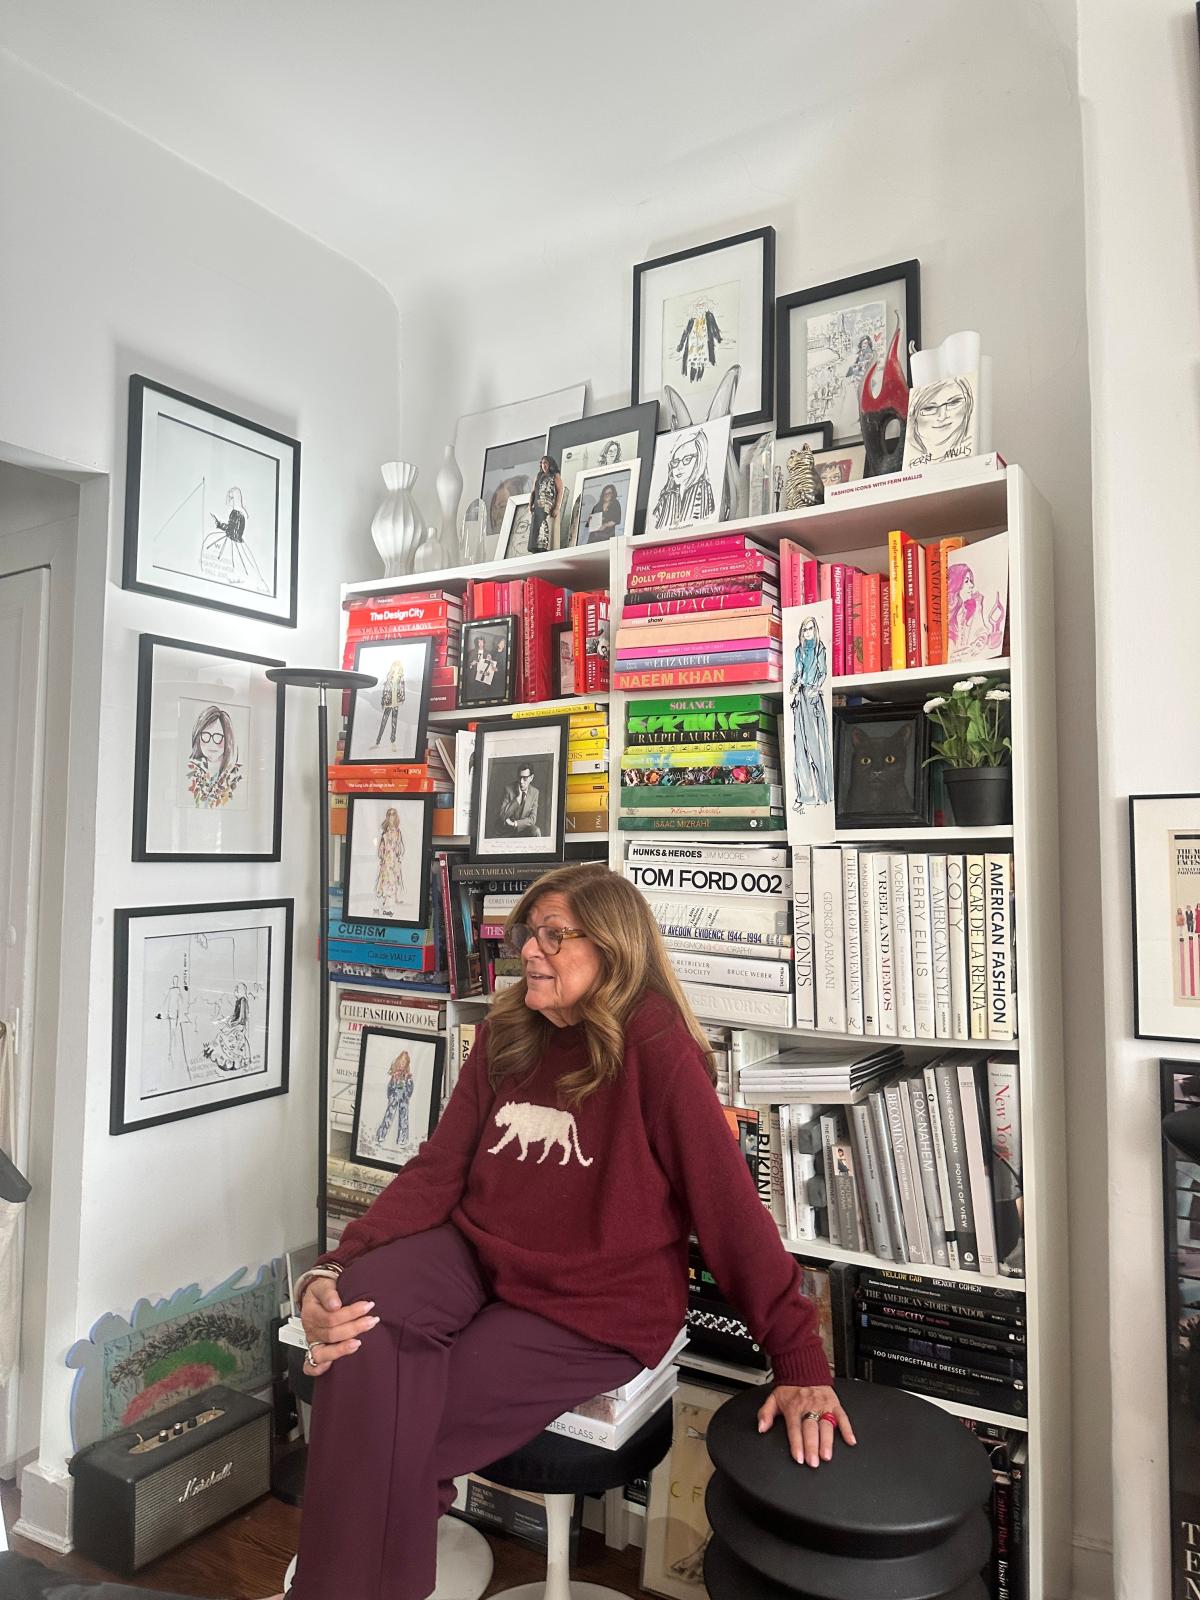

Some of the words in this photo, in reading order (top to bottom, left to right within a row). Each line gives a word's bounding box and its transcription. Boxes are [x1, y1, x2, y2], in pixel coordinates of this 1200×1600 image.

[831, 488, 854, 497] FASHION
[855, 484, 872, 492] ICONS
[872, 481, 887, 489] WITH
[887, 478, 902, 486] FERN
[902, 473, 923, 483] MALLIS
[631, 574, 656, 586] DOLLY
[657, 569, 691, 583] PARTON
[370, 612, 383, 621] The
[384, 609, 408, 620] Design
[408, 608, 424, 618] City
[646, 594, 730, 616] IMPACT
[882, 587, 890, 627] VIVIENNE
[653, 655, 710, 668] ELIZABETH
[619, 672, 674, 687] NAEEM
[678, 669, 725, 685] KHAN
[669, 701, 716, 710] SOLANGE
[638, 733, 676, 744] RALPH
[680, 730, 727, 741] LAUREN
[654, 819, 675, 828] ISAAC
[677, 818, 710, 827] MIZRAHI
[632, 848, 661, 857] HUNKS
[668, 850, 702, 858] HEROES
[719, 852, 745, 860] MOORE
[847, 856, 856, 880] THE
[630, 867, 674, 887] TOM
[679, 870, 738, 891] FORD
[741, 873, 782, 894] 002
[860, 863, 868, 898] MANOLO
[894, 864, 904, 902] VICENTE
[913, 865, 926, 920] PERRY
[969, 864, 984, 912] OSCAR
[878, 870, 890, 954] VREELAND
[948, 863, 963, 932] COTY
[990, 862, 1004, 945] AMERICAN
[823, 891, 834, 939] GIORGIO
[896, 905, 906, 932] WOLF
[933, 887, 948, 962] AMERICAN
[970, 917, 985, 937] DE
[338, 924, 386, 938] CUBISM
[667, 927, 691, 938] AVEDON
[694, 928, 724, 940] EVIDENCE
[795, 892, 812, 987] DIAMONDS
[677, 960, 710, 968] RETRIEVER
[915, 930, 928, 977] ELLIS
[971, 942, 985, 959] LA
[750, 971, 772, 979] WEBER
[824, 943, 835, 990] ARMANI
[849, 936, 861, 1004] MOVEMENT
[881, 957, 893, 1011] MEMOS
[936, 967, 950, 1008] STYLE
[972, 965, 986, 1011] RENTA
[992, 952, 1006, 1023] FASHION
[944, 1076, 952, 1106] TONNE
[887, 1093, 904, 1153] BECOMING
[913, 1091, 934, 1172] FOX-NAHEM
[947, 1107, 958, 1153] GOODMAN
[758, 1134, 771, 1202] BIKINI
[771, 1153, 780, 1193] PEOPLE
[959, 1191, 964, 1204] OF
[865, 1289, 881, 1299] THE
[883, 1293, 922, 1306] AMERICAN
[924, 1300, 950, 1312] STORE
[951, 1305, 985, 1318] WINDOW
[905, 1311, 925, 1321] CITY
[887, 1353, 938, 1370] UNFORGETTABLE
[939, 1364, 967, 1376] DRESSES
[568, 1425, 594, 1440] CLASS
[178, 1462, 233, 1503] Marshall
